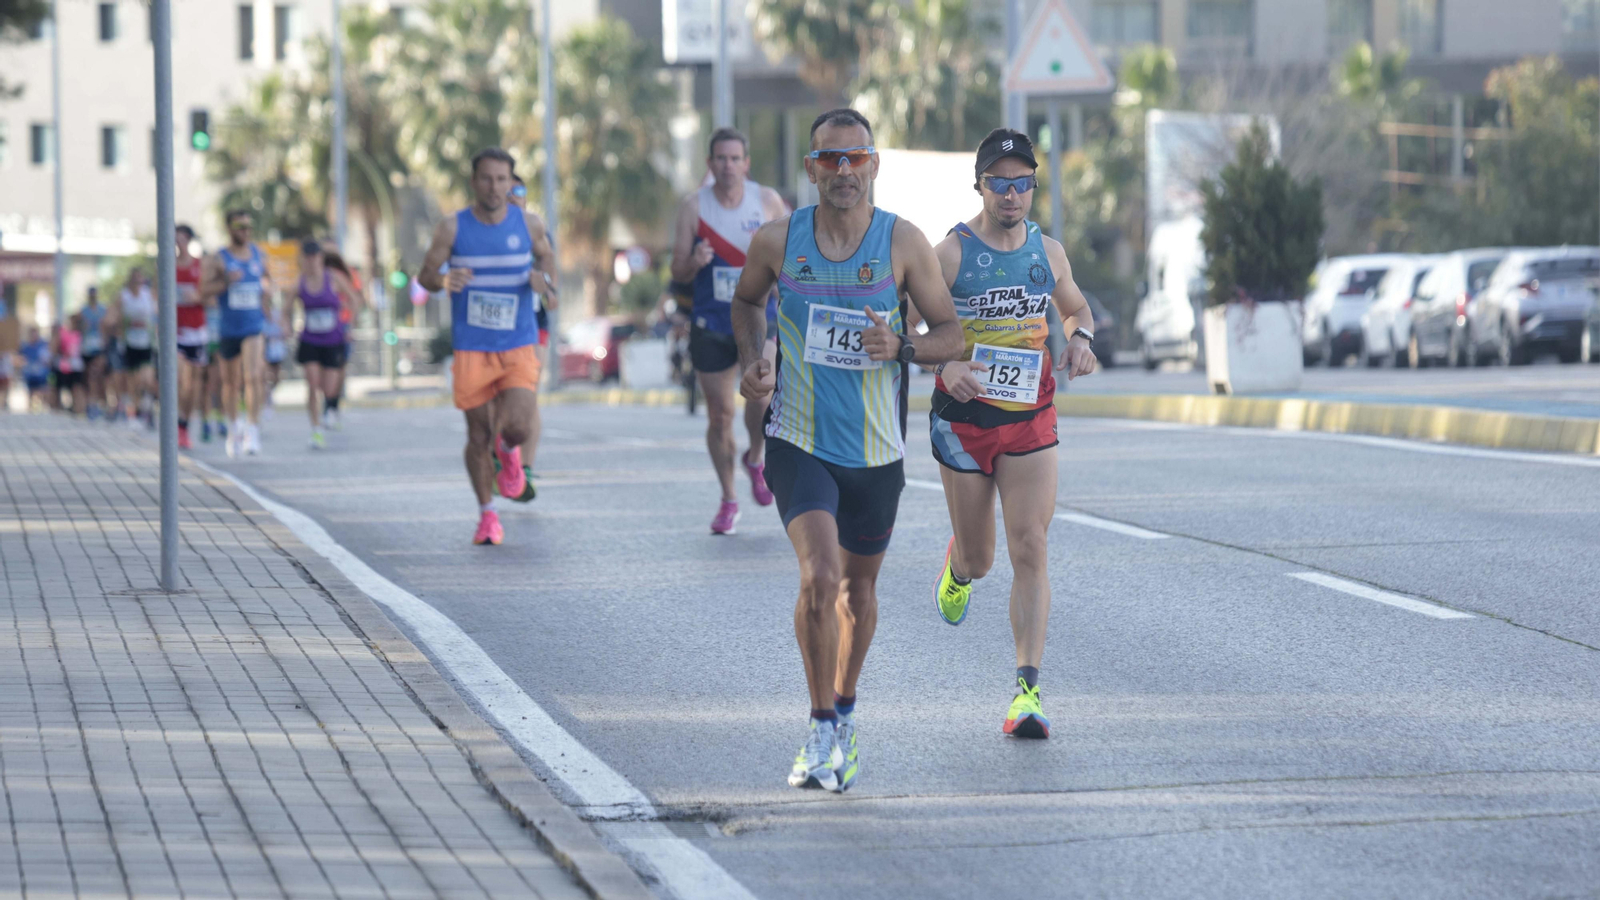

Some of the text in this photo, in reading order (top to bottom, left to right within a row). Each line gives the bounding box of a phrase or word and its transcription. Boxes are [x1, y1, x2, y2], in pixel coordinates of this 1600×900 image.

[988, 289, 1025, 304] TRAIL
[979, 305, 1017, 318] TEAM
[834, 314, 867, 326] MARATÓN
[826, 327, 863, 352] 143
[825, 355, 861, 365] EVOS
[995, 353, 1024, 362] MARATÓN
[988, 363, 1021, 387] 152
[987, 388, 1017, 398] EVOS
